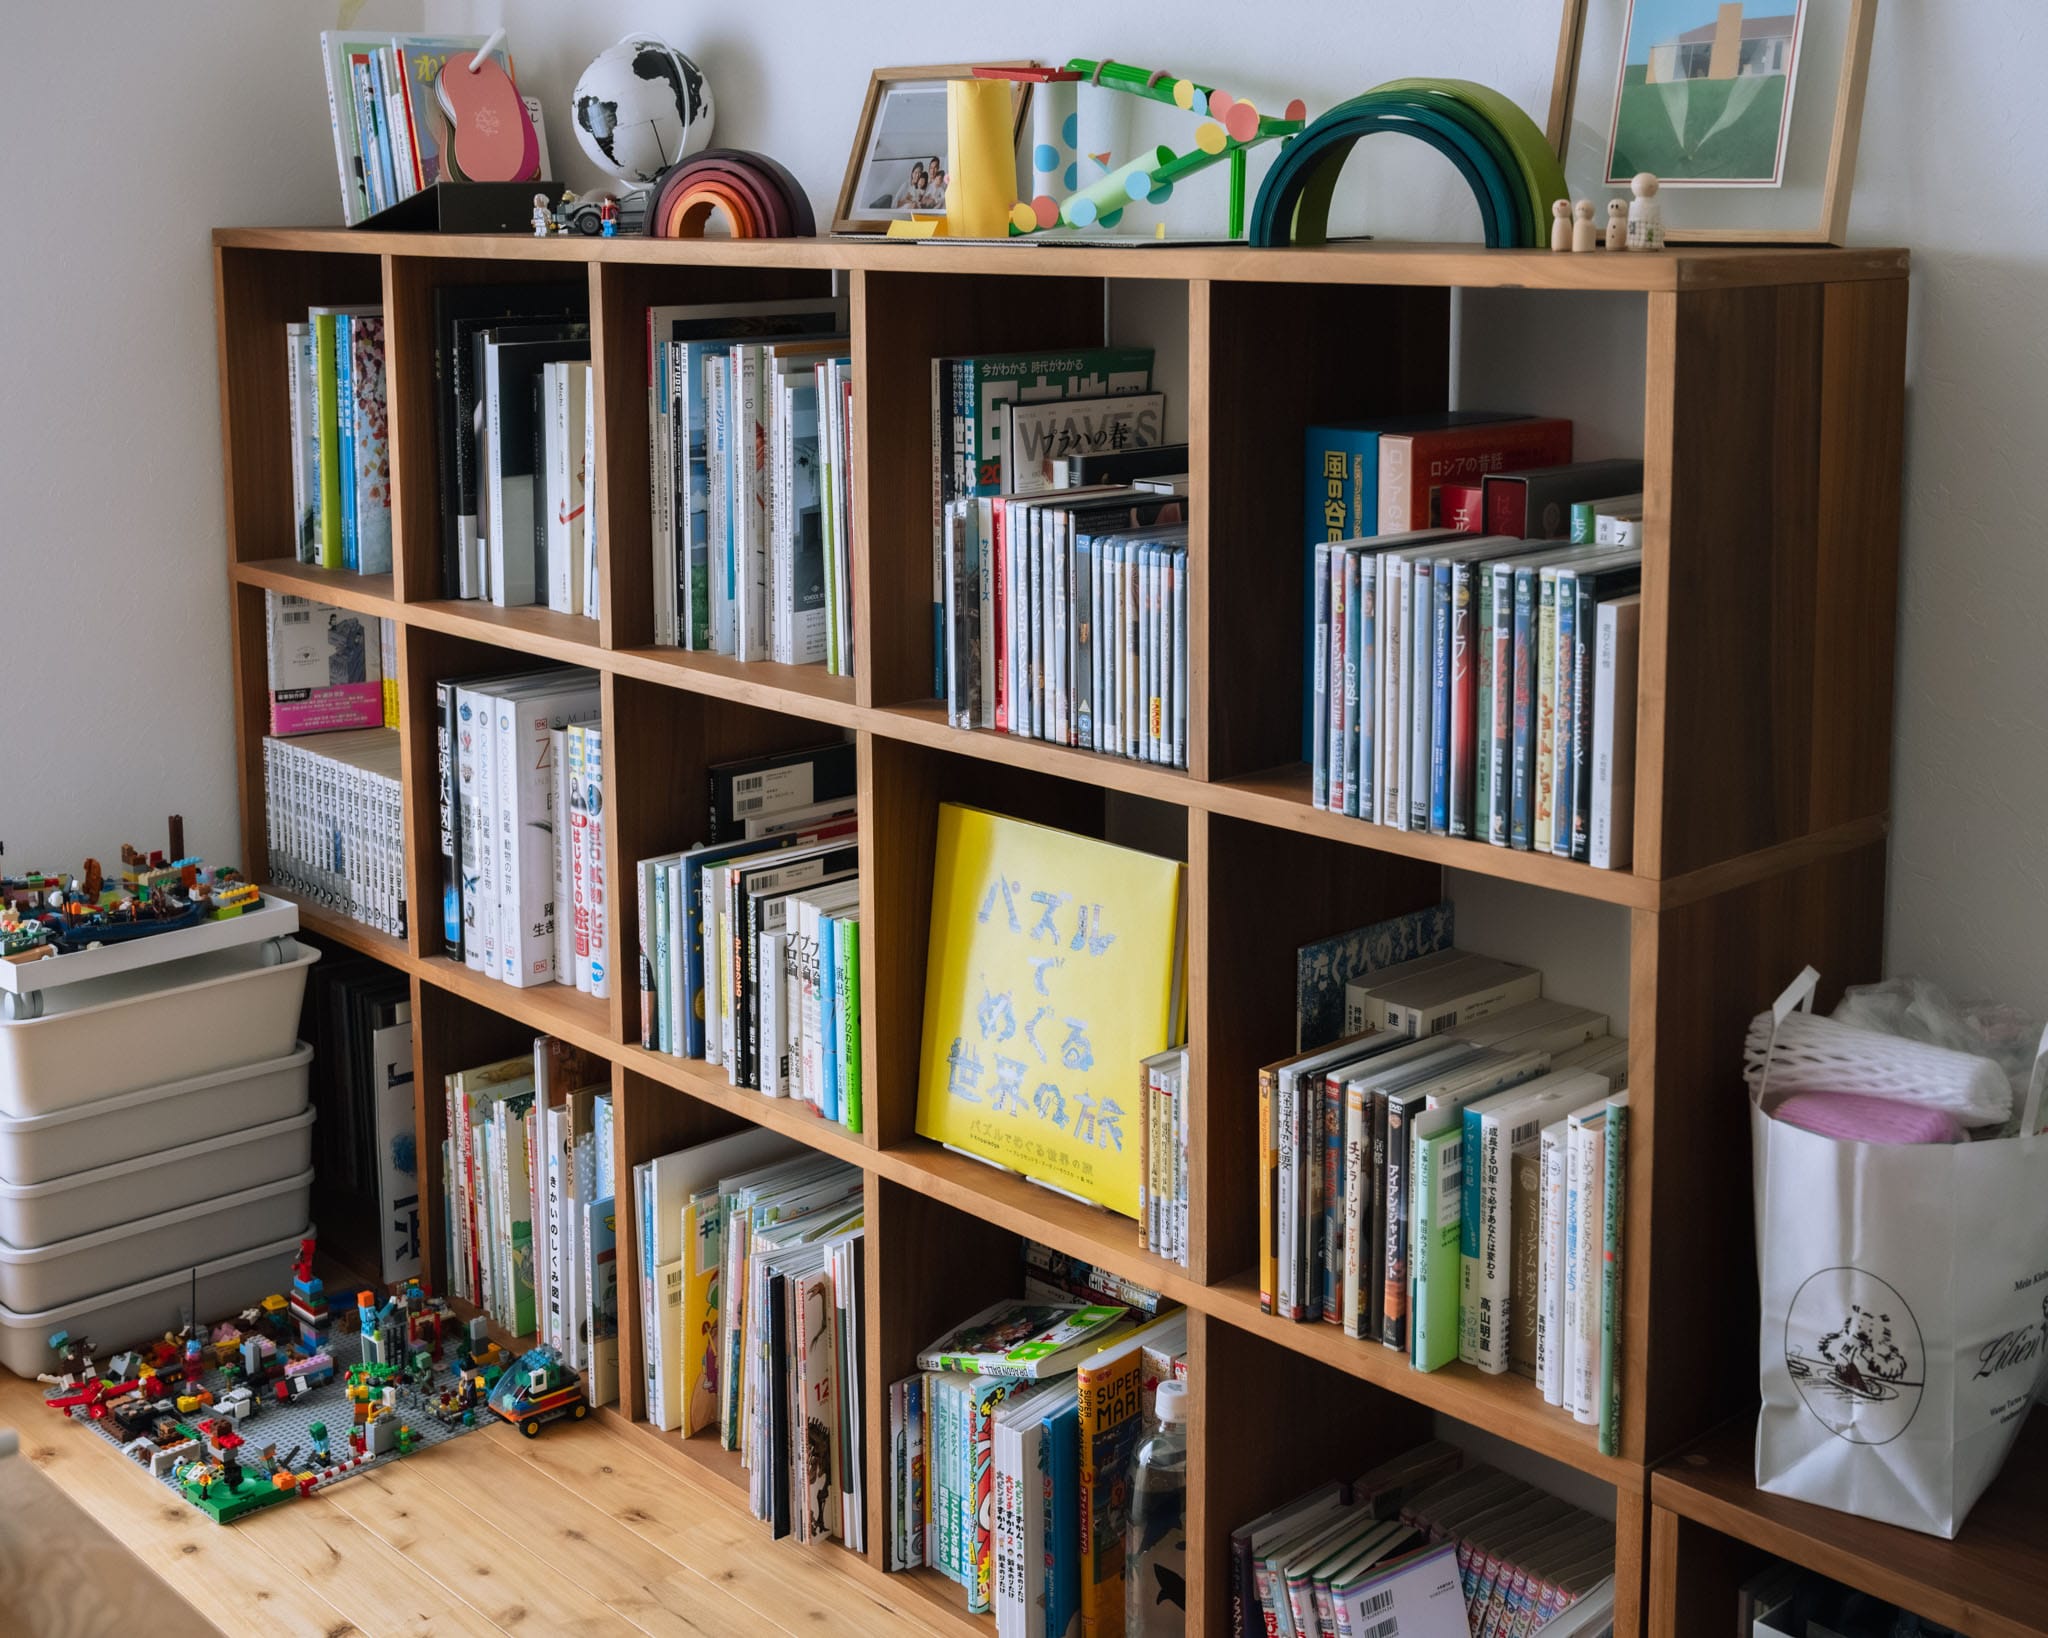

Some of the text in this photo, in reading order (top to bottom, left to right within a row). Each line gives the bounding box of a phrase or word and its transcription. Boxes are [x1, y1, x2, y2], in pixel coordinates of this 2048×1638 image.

[743, 357, 754, 409] LEE 10
[981, 359, 1084, 377] 今がわかる 時代がわかる
[1019, 410, 1158, 462] WAVES
[1042, 421, 1130, 453] プラハの春
[1430, 453, 1504, 478] ロシアの昔話
[981, 539, 990, 601] サマーウォーズ
[1456, 608, 1468, 681] アラン
[1345, 661, 1359, 707] crash
[503, 839, 513, 896] 動物の世界
[571, 829, 591, 958] はじめての絵画
[702, 873, 713, 938] 絵本の力
[978, 872, 1117, 957] パズル
[535, 961, 547, 973] DK
[1027, 956, 1065, 996] で
[977, 989, 1095, 1072] めぐる
[946, 1036, 1127, 1153] 世界の旅
[970, 1119, 1094, 1176] パズルでめぐる世界の旅
[1279, 1091, 1292, 1170] 深呼吸の必要
[1464, 1122, 1475, 1187] シャトル日記
[1348, 1140, 1360, 1219] チェブラーシカ
[1486, 1127, 1499, 1280] 成長する10年で必ずあなたは変わる
[549, 1175, 560, 1317] きかいのしくみ図鑑
[1387, 1164, 1399, 1279] アイアン・ジャイアント
[1525, 1198, 1538, 1268] ミュージアム
[1002, 1366, 1029, 1377] DRAGON
[1096, 1368, 1141, 1405] SUPER
[1083, 1389, 1092, 1418] SUPER
[996, 1470, 1006, 1594] 大ピンチずかん 鈴木のりたけ
[1080, 1487, 1088, 1553] オフィシャルガイド
[1007, 1559, 1015, 1599] 鈴木のりたけ
[1017, 1563, 1025, 1604] 鈴木のりたけ
